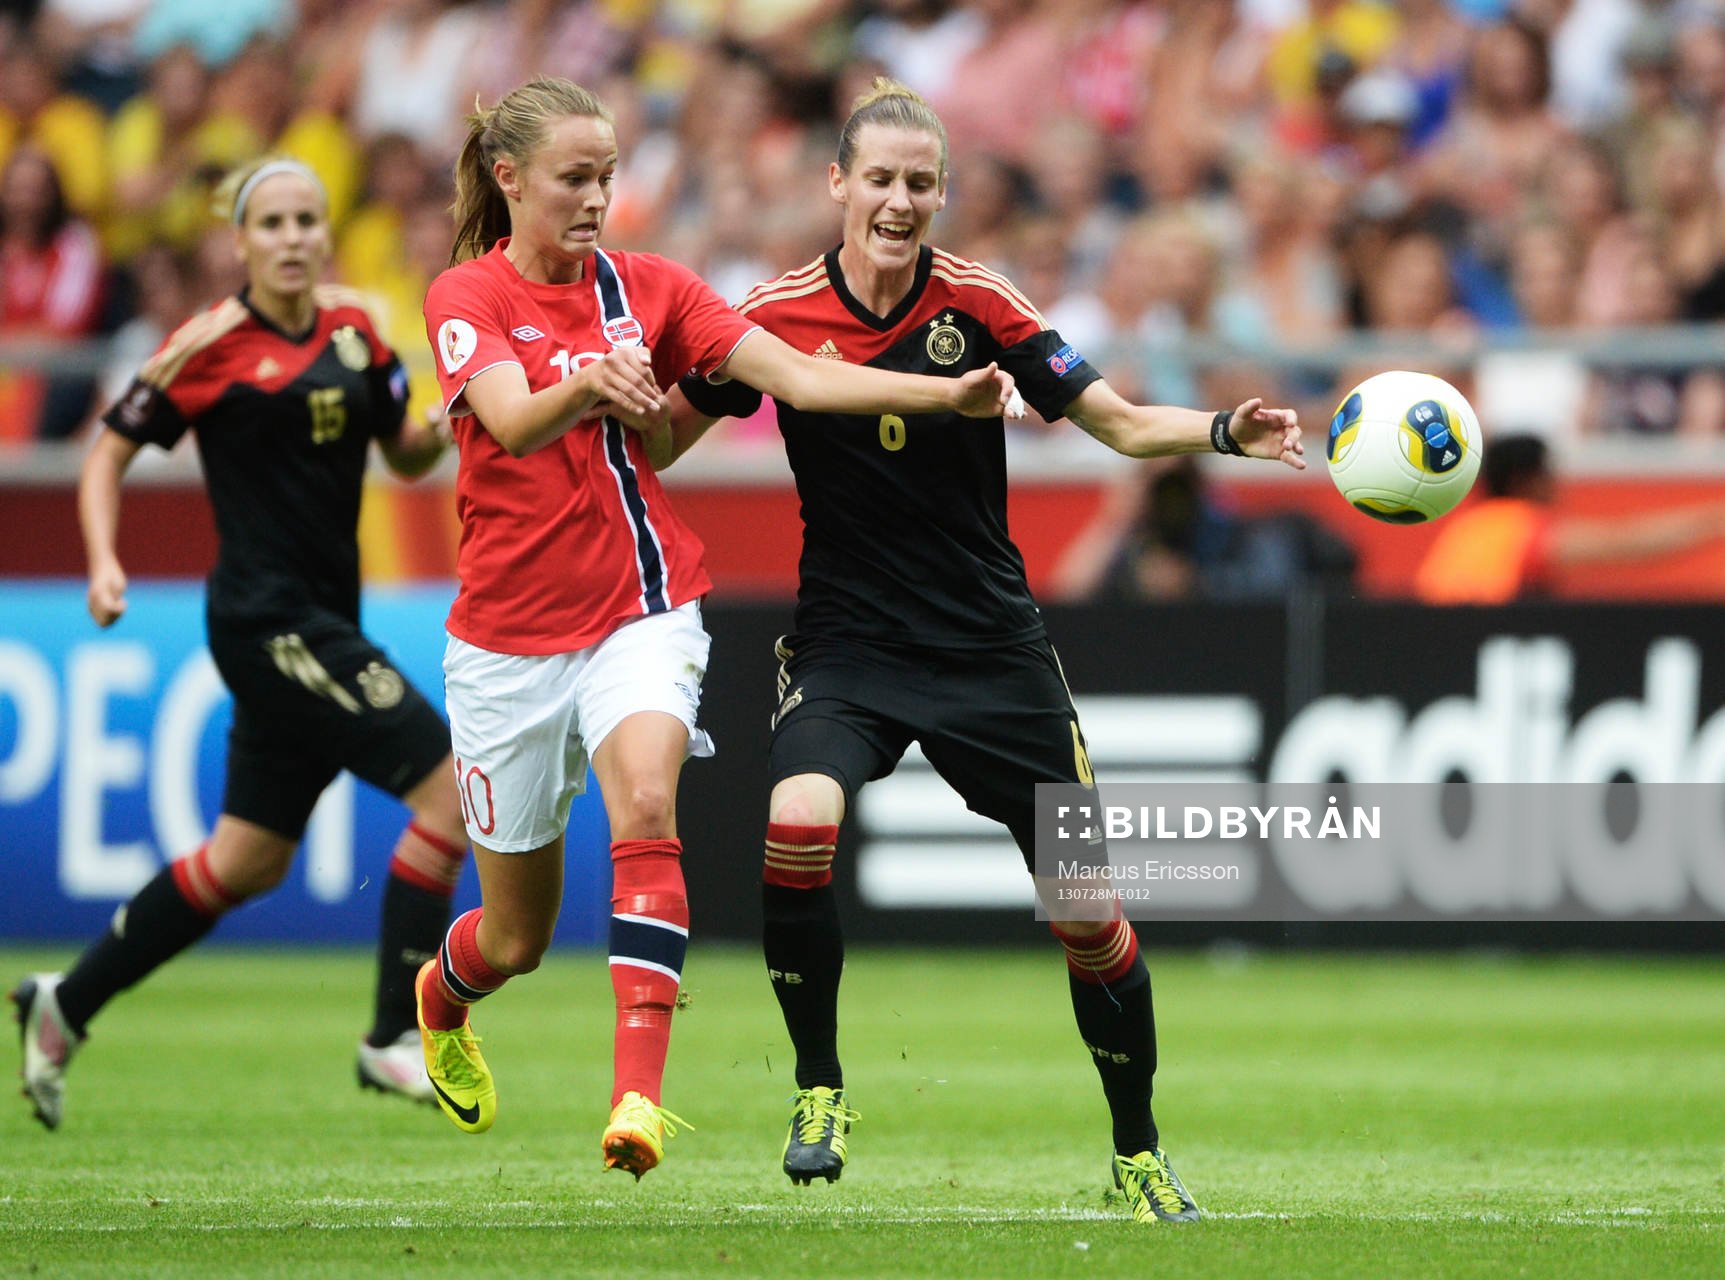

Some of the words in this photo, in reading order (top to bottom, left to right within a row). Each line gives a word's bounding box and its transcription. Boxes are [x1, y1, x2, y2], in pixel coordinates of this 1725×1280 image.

[308, 386, 346, 444] 15
[879, 414, 906, 451] 6
[1070, 720, 1094, 790] 6
[1265, 634, 1725, 918] adid
[456, 756, 495, 835] 10
